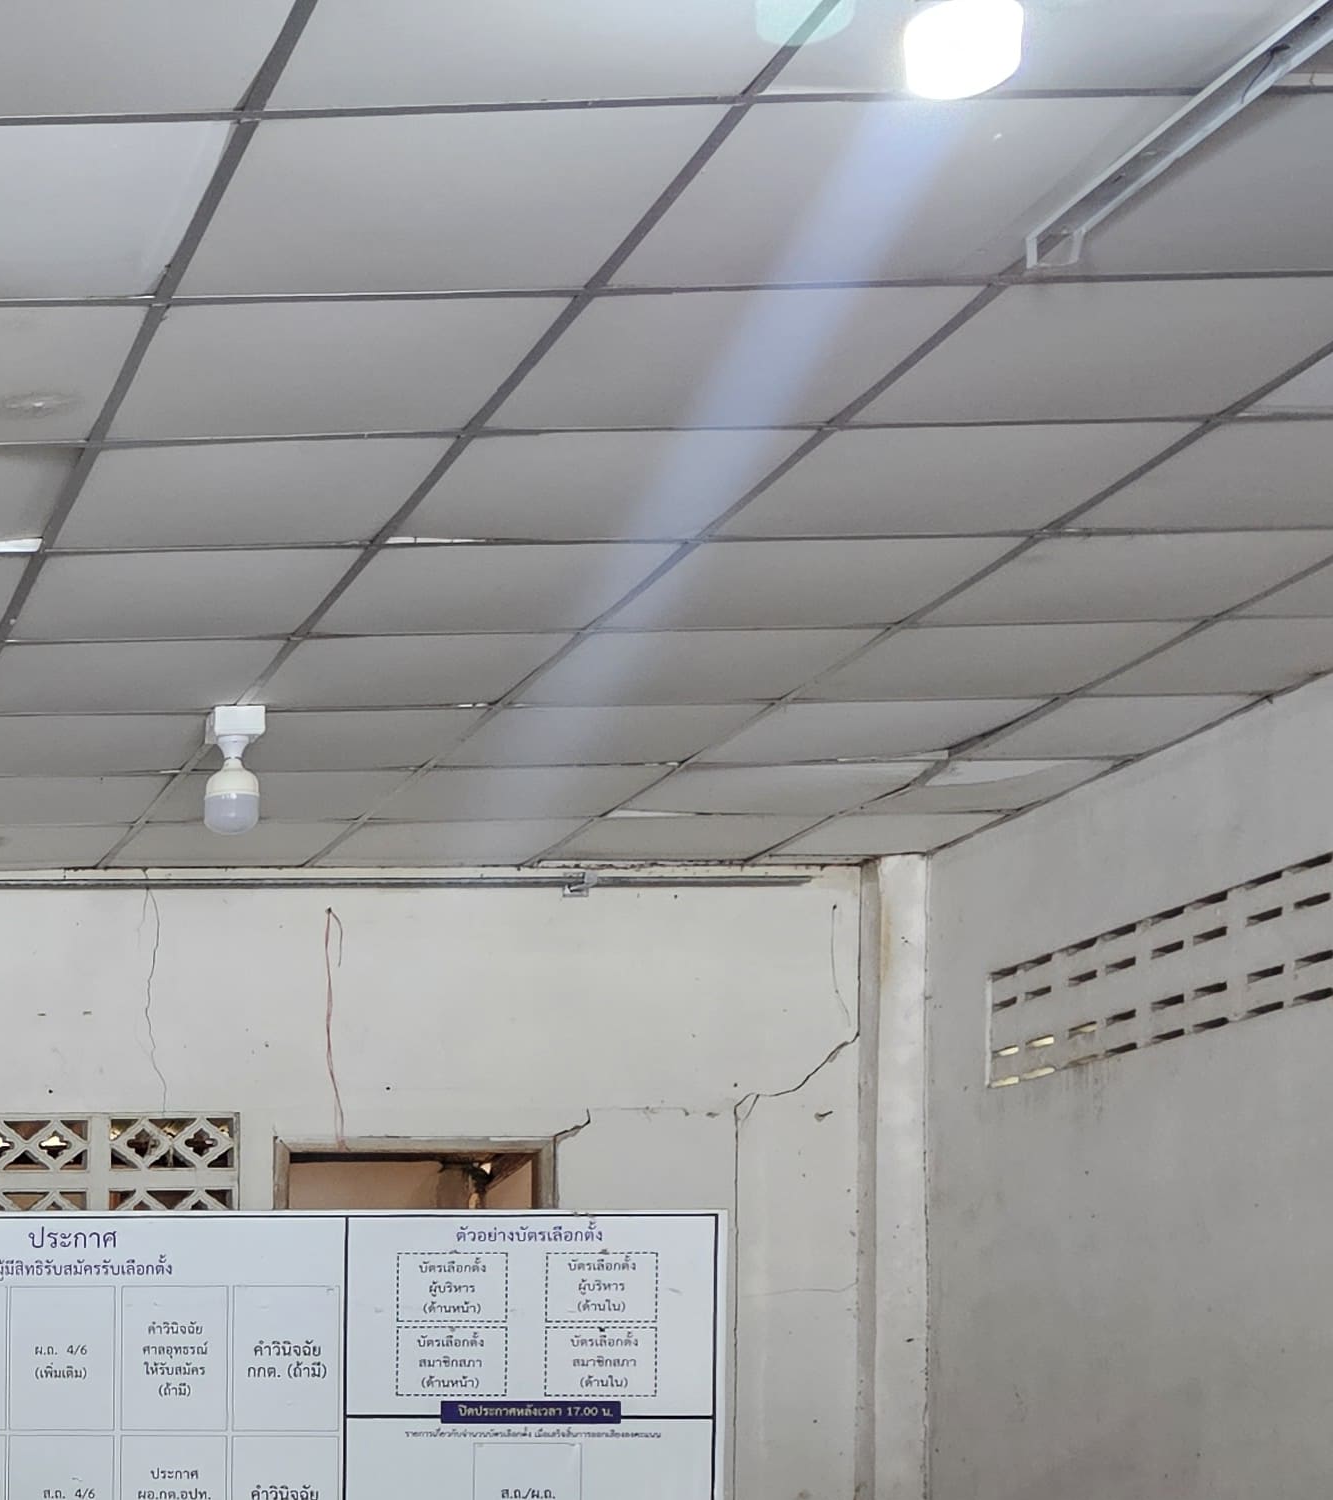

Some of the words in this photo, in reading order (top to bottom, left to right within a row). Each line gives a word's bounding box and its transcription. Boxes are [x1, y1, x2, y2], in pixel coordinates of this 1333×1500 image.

[27, 1225, 118, 1249] ประกาศ
[456, 1221, 603, 1243] ตัวอย่างบัตรเลือกตั้ง
[419, 1257, 487, 1274] บัตรเลือกตั้ง
[567, 1255, 637, 1273] บัตรเลือกตั้ง
[428, 1280, 476, 1298] ผู้บริหาร
[577, 1277, 626, 1296] ผู้บริหาร
[422, 1300, 482, 1315] (ด้านหน้า)
[577, 1299, 626, 1314] (ด้านใน)
[147, 1320, 204, 1335] คำวินิจฉัย
[253, 1339, 322, 1358] คำวินิจฉัย
[417, 1331, 485, 1349] บัตรเลือกตั้ง
[571, 1331, 639, 1349] บัตรเลือกตั้ง
[34, 1345, 58, 1356] ผ.ถ.
[66, 1344, 88, 1356] 4/6
[142, 1340, 209, 1360] ศาลอุทธรณ์
[143, 1357, 206, 1376] ให้รับสมัคร
[247, 1366, 281, 1378] กกต.
[287, 1360, 327, 1380] (ถ้ามี)
[418, 1355, 483, 1368] สมาชิกสภา
[572, 1355, 637, 1368] สมาชิกสภา
[34, 1361, 87, 1380] (เพิ่มเติม)
[158, 1381, 191, 1398] (ถ้ามี)
[420, 1375, 480, 1389] (ด้านหน้า)
[579, 1374, 629, 1389] (ด้านใน)
[457, 1403, 563, 1417] ปิดประกาศหลังเวลา
[566, 1406, 599, 1417] 17.00
[601, 1407, 614, 1417] น.
[150, 1467, 199, 1480] ประกาศ
[43, 1489, 66, 1500] ส.ถ.
[74, 1487, 96, 1500] 4/6
[500, 1487, 556, 1500] ส.ถ./ผ.ถ.
